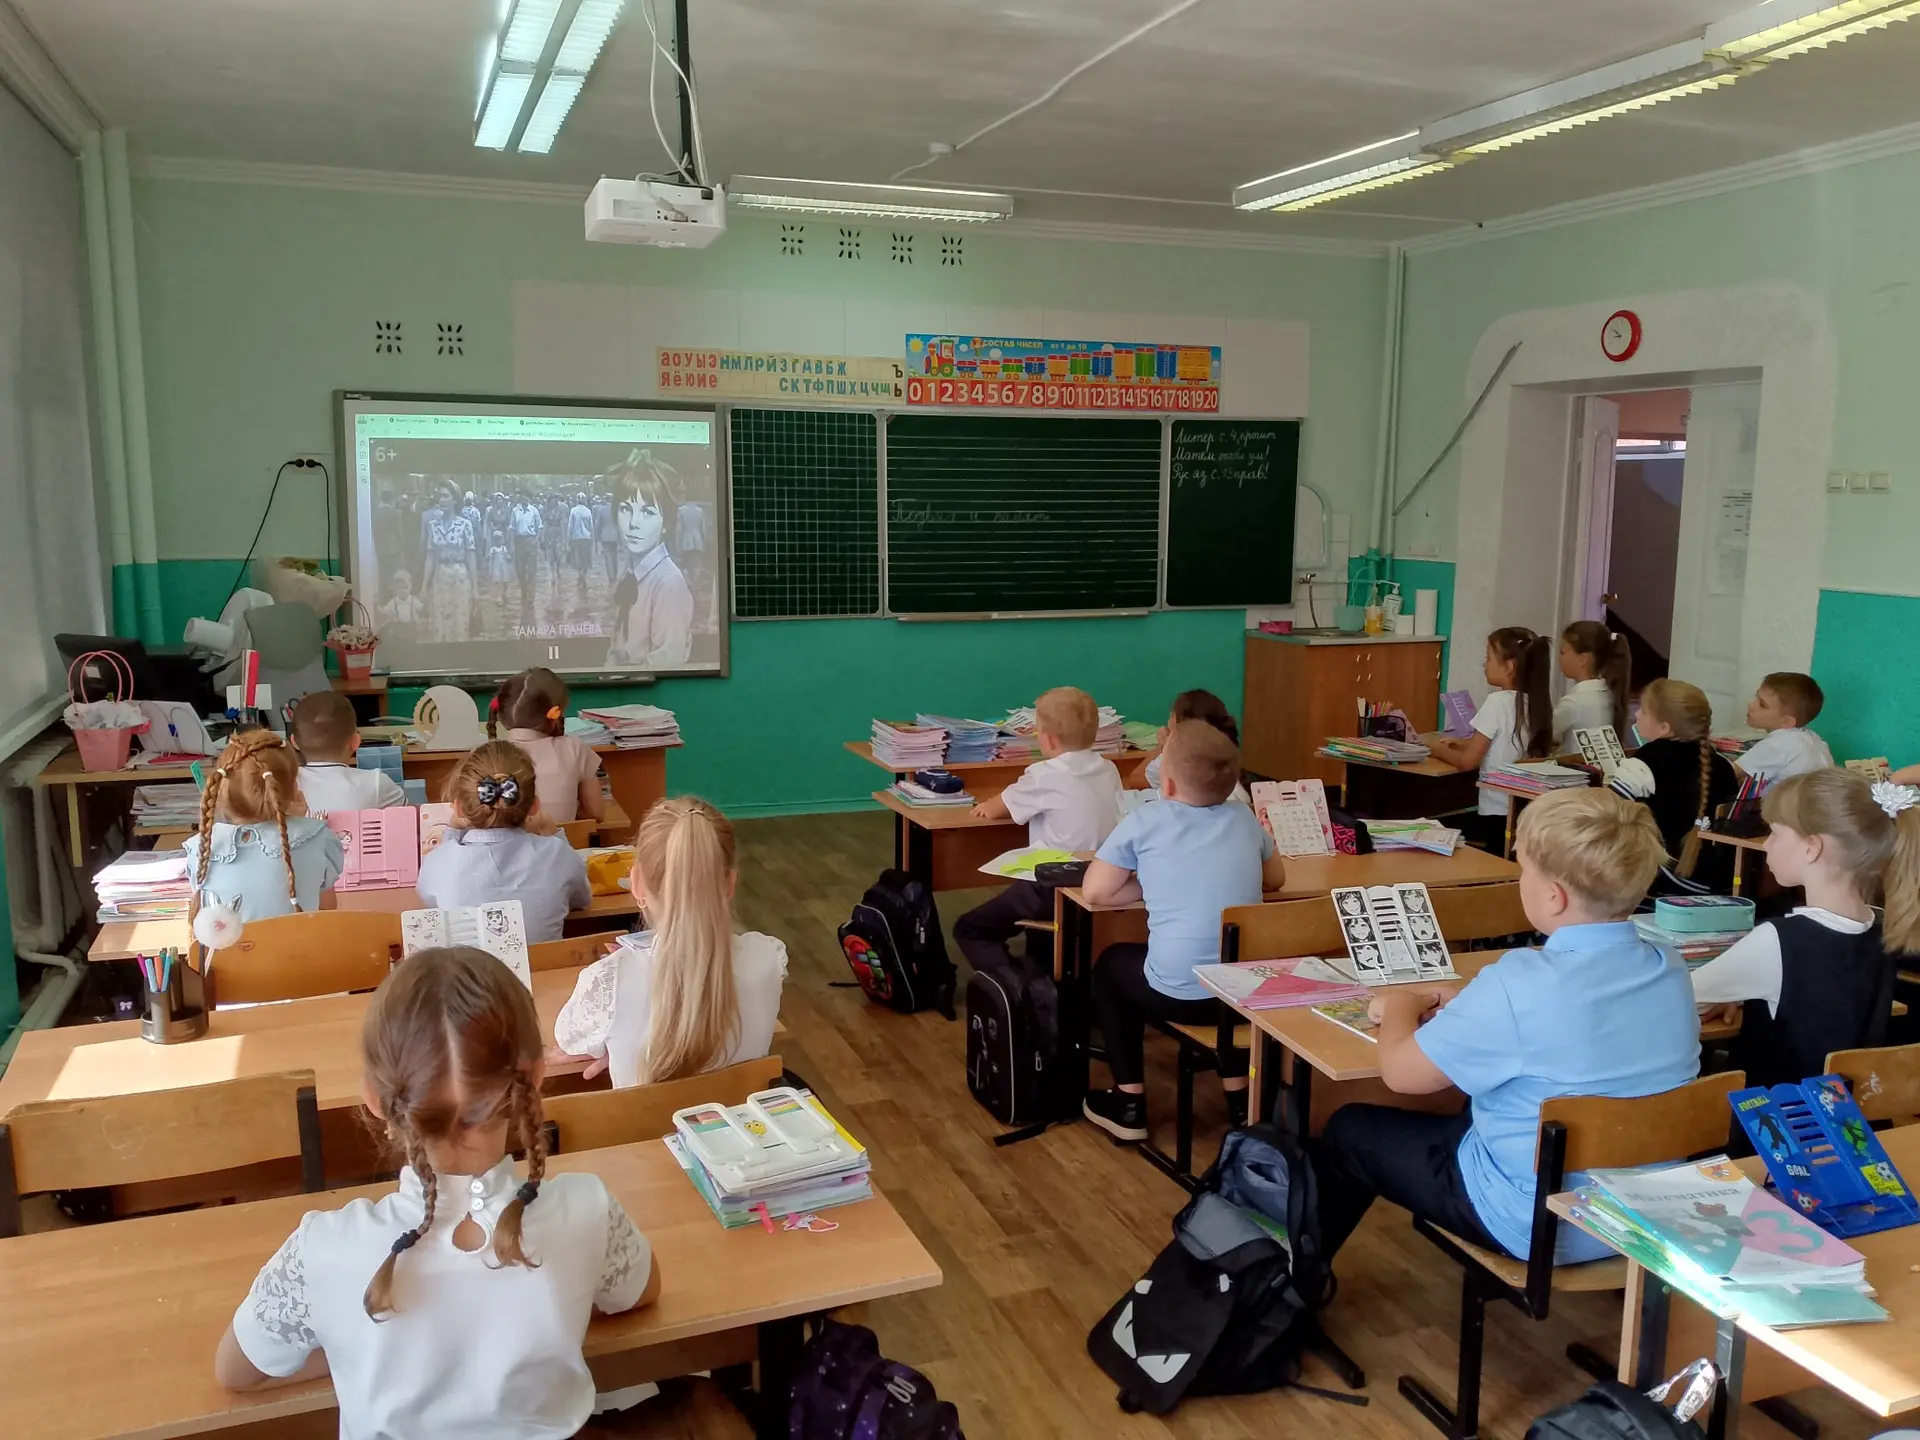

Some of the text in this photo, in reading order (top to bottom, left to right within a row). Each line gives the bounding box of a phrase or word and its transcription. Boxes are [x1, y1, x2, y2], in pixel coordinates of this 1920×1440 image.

[983, 339, 1015, 348] СОСТАВ
[1017, 340, 1043, 349] ЧИСЕЛ
[909, 382, 1218, 409] 0 1 2 3 4 5 6 7 8 9 10 11 12 13 14 15 16 17 18 19 20
[375, 446, 397, 462] 6+
[512, 624, 557, 637] ТАМАРА
[1785, 1164, 1811, 1177] GOAL
